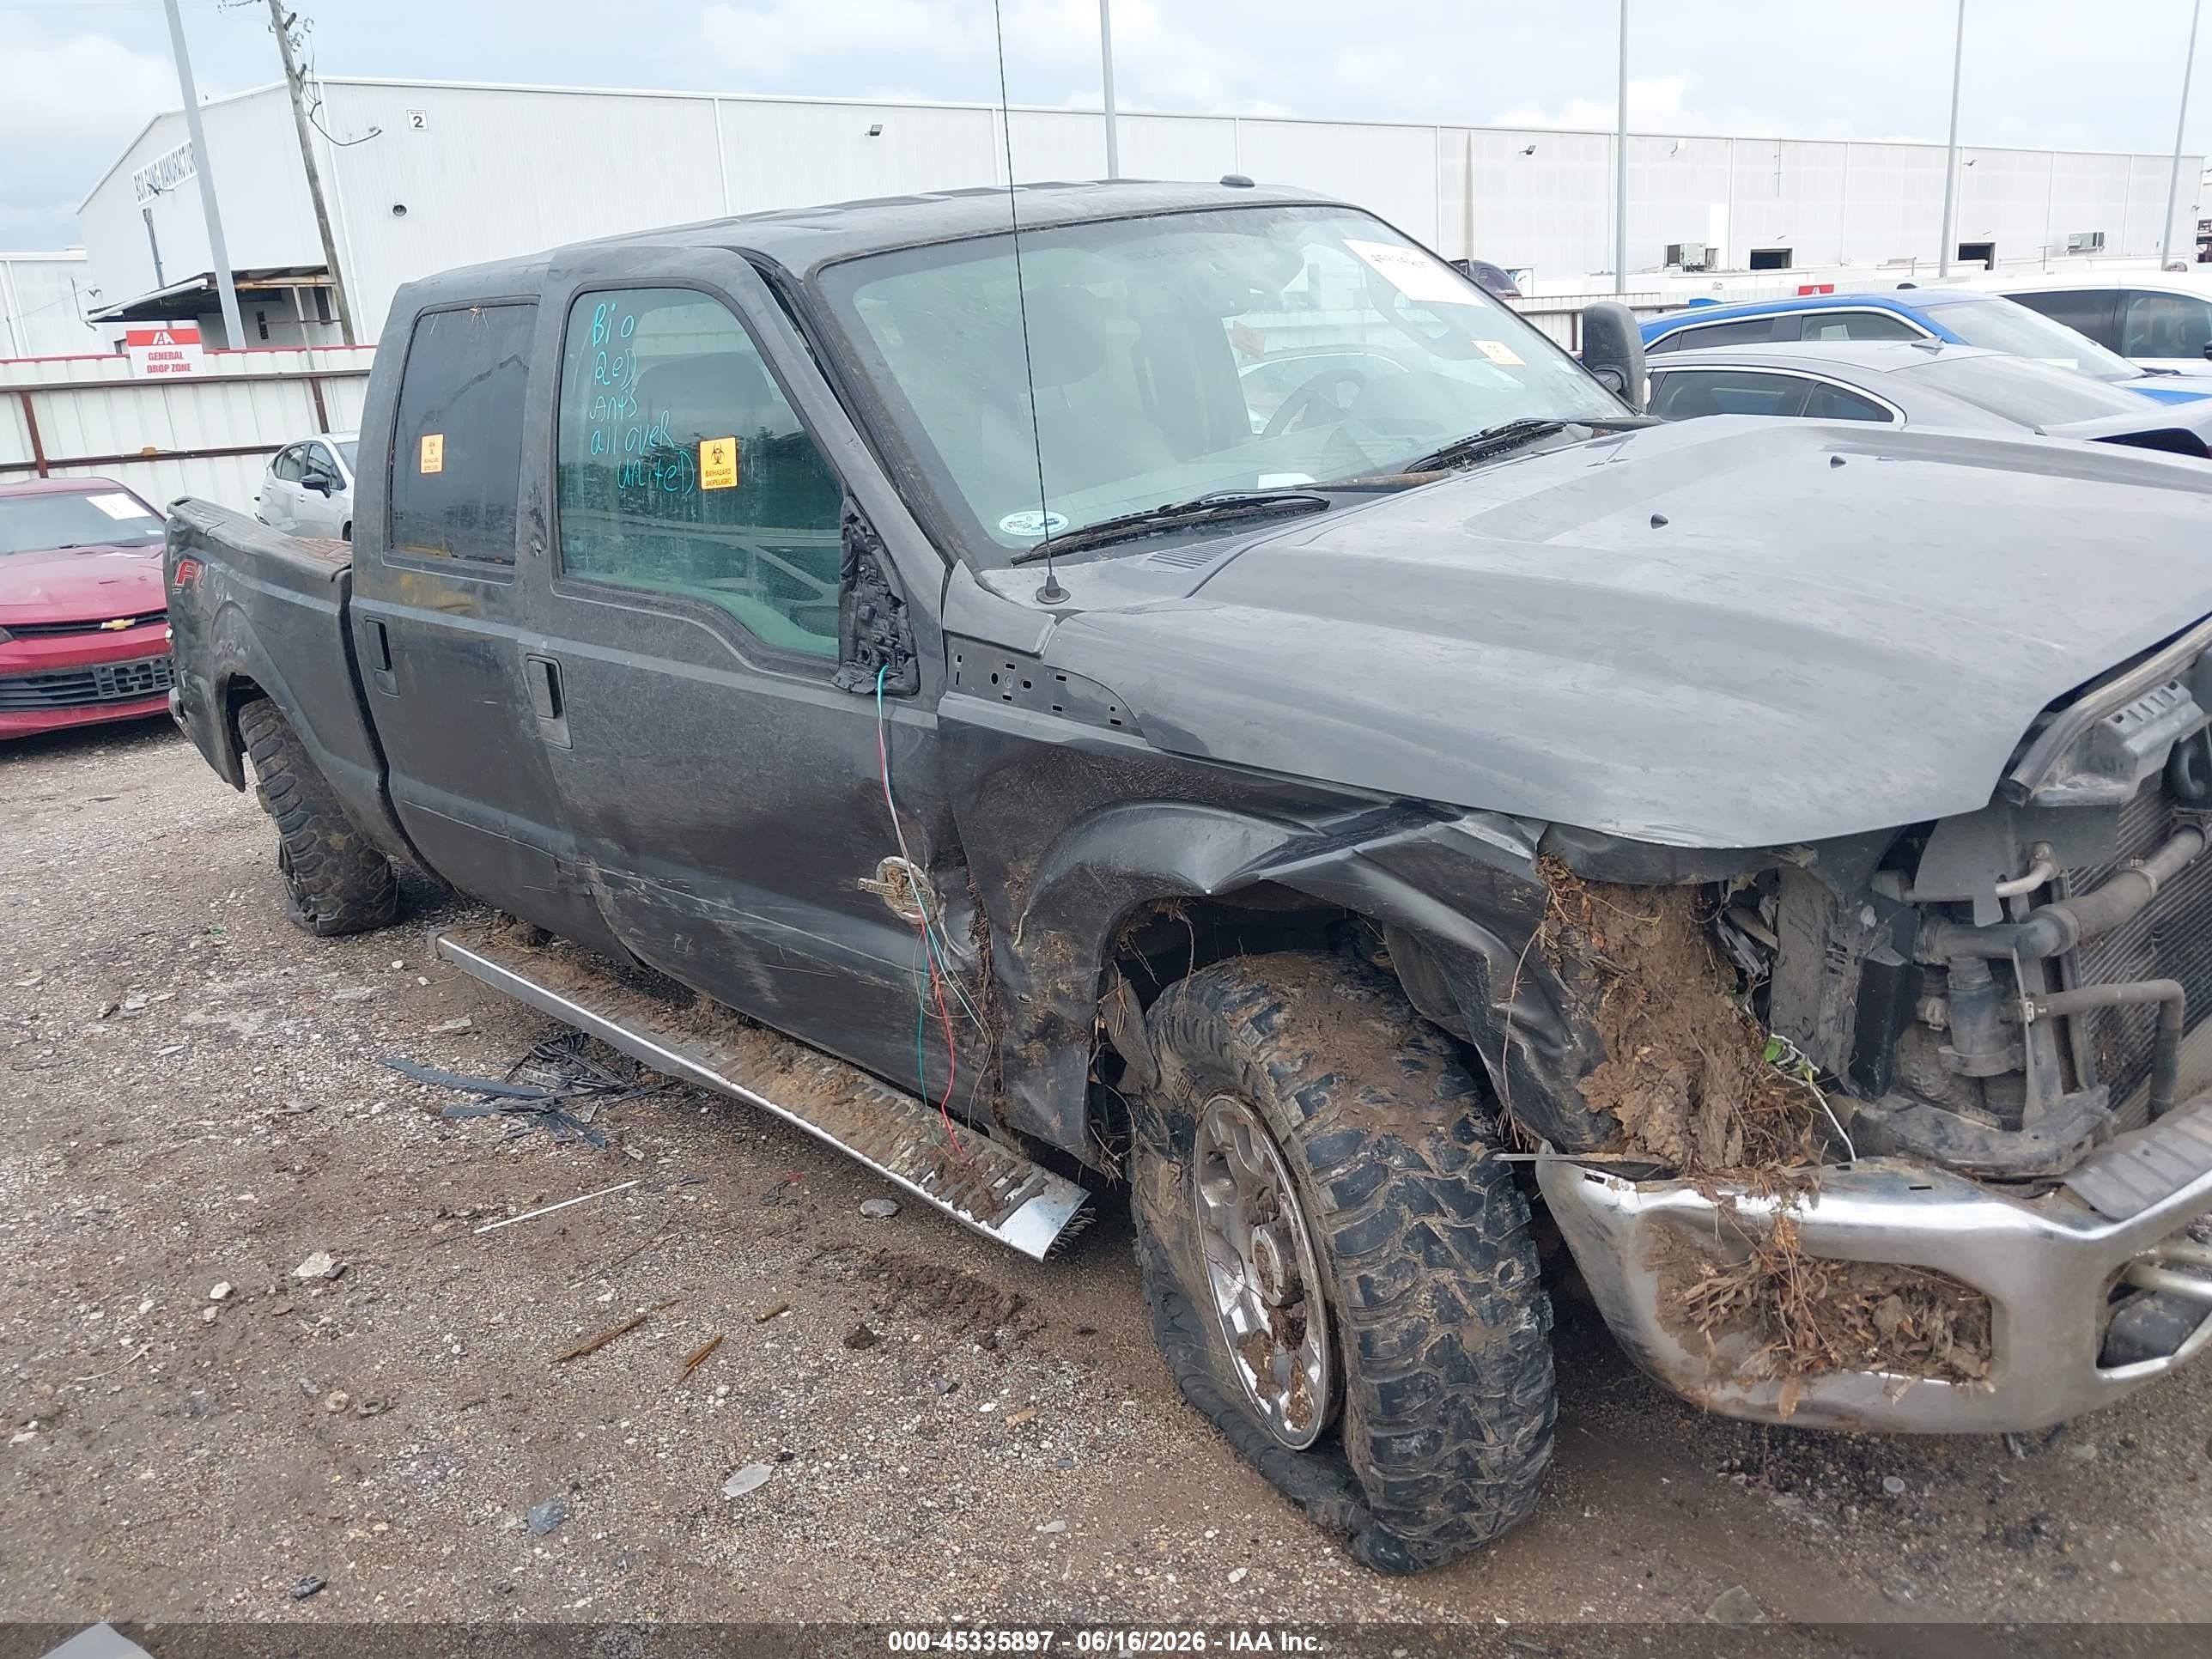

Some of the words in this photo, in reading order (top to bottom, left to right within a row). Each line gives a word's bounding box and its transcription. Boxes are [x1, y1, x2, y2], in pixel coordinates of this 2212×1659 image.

[413, 116, 423, 128] 2
[148, 350, 185, 362] GENERAL
[146, 364, 170, 374] DROP
[171, 363, 192, 373] ZONE
[705, 468, 732, 477] BIOHAZARD
[705, 477, 732, 487] BIOPELIGRO
